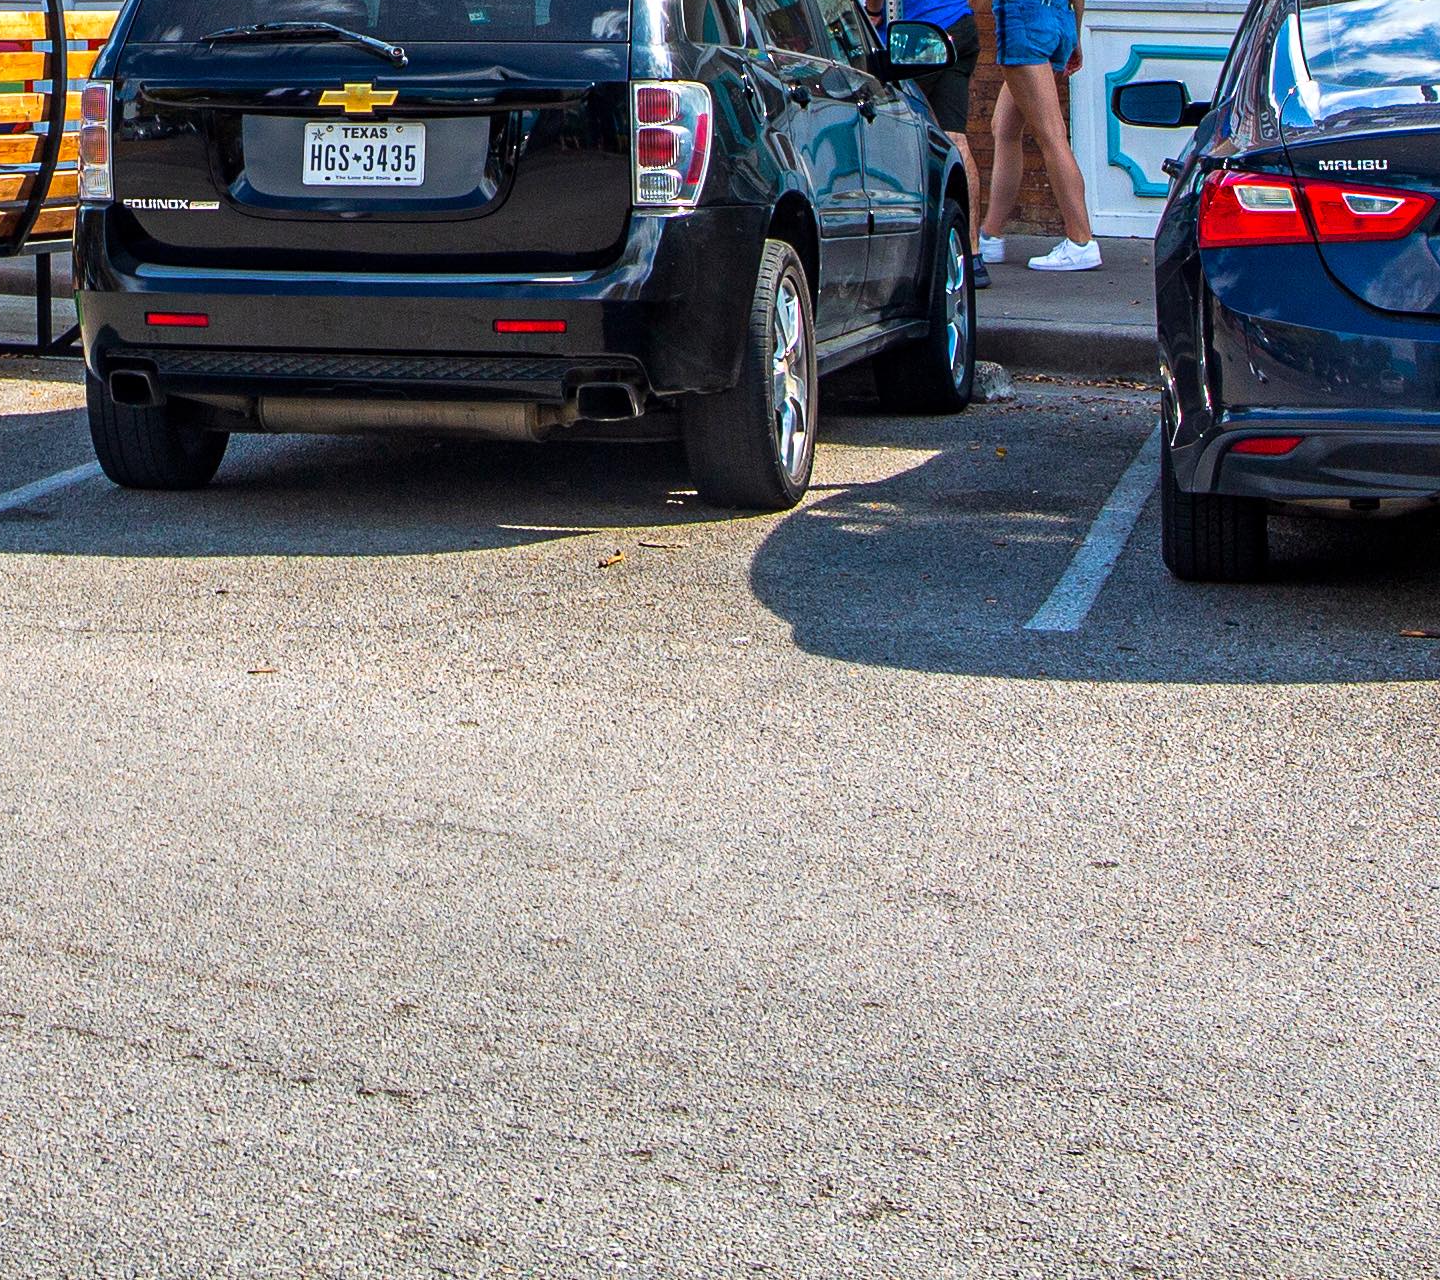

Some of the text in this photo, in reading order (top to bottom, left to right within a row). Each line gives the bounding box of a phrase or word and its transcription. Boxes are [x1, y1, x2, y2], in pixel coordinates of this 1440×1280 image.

[342, 127, 388, 139] TEXAS
[1318, 159, 1388, 171] MALIBU
[123, 198, 189, 210] EQUINOX
